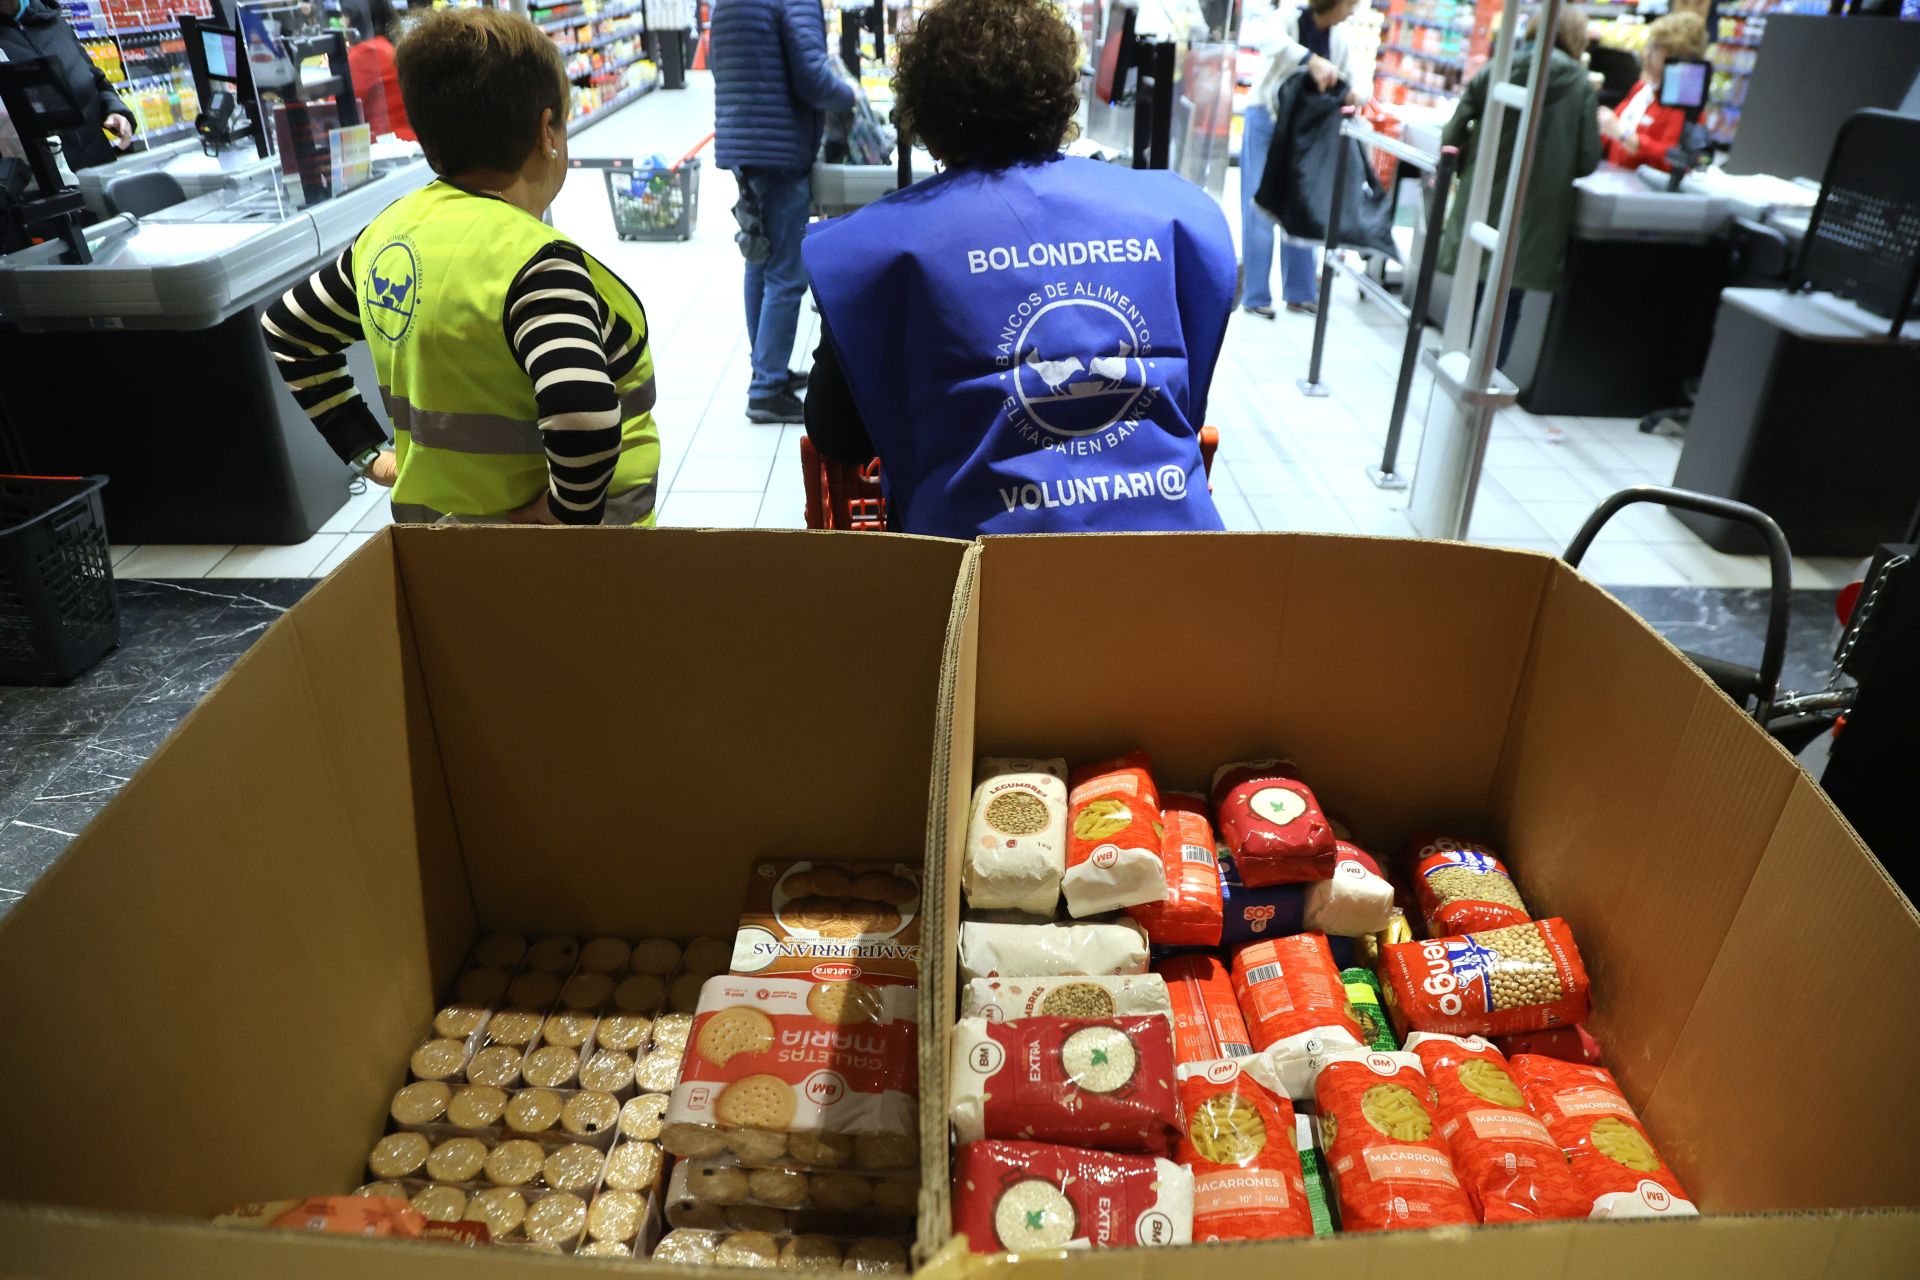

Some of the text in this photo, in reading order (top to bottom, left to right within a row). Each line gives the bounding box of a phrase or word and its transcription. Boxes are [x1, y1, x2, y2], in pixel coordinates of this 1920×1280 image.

[967, 238, 1162, 274] BOLONDRESA
[995, 281, 1153, 367] BANCOS DE ALIMENTOS
[1002, 385, 1161, 456] ELIKAGAIEN BANKUA
[998, 464, 1188, 513] VOLUNTARI@
[989, 782, 1049, 798] LEGUMBRES
[1097, 851, 1113, 863] BM
[1244, 905, 1275, 921] SOS
[752, 942, 923, 961] CAMPURRIANAS
[815, 966, 859, 978] Cuétara
[778, 1050, 882, 1070] GALLETAS
[979, 1048, 990, 1067] BM
[1029, 1040, 1041, 1082] EXTRA
[1373, 1059, 1391, 1067] BM
[1213, 1064, 1233, 1076] BM
[812, 1083, 836, 1094] BM
[1370, 1152, 1450, 1167] MACARRONES
[1646, 1190, 1665, 1201] BM
